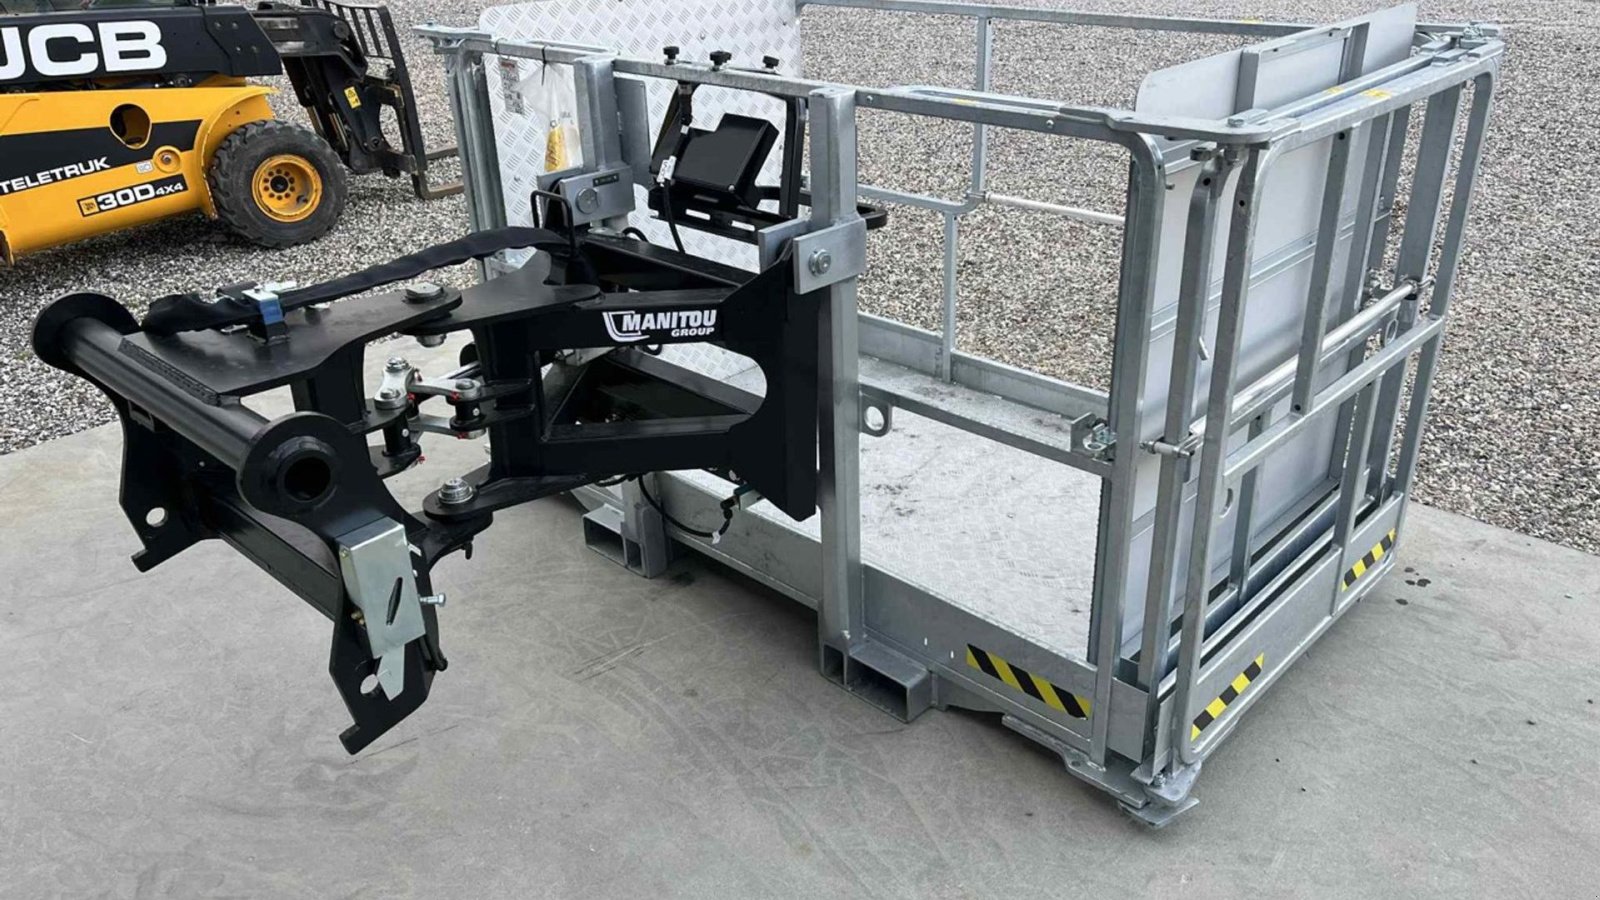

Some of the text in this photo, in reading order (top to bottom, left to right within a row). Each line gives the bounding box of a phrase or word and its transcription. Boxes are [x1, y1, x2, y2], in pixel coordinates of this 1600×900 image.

[0, 20, 167, 79] JCB
[0, 157, 110, 194] TELETRUK
[97, 183, 155, 211] 30D
[622, 310, 717, 331] MANITOU
[671, 327, 715, 337] GROUP
